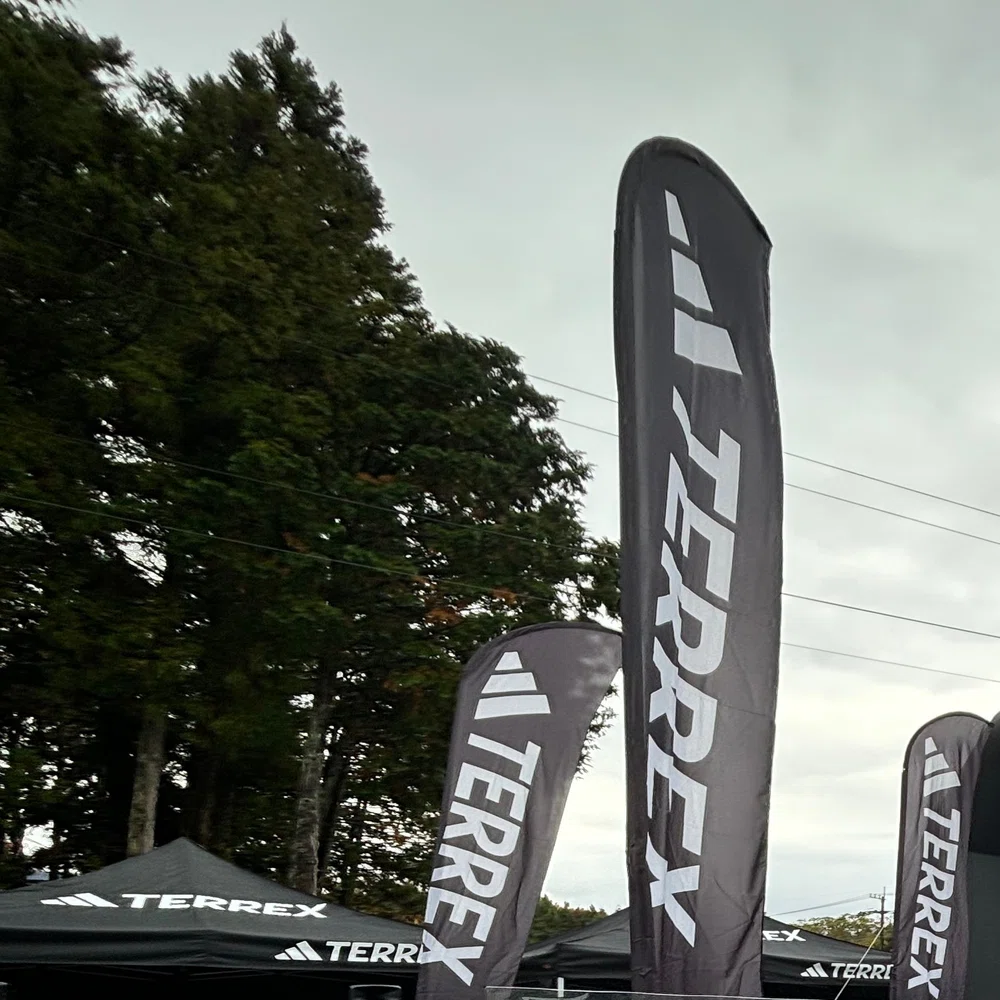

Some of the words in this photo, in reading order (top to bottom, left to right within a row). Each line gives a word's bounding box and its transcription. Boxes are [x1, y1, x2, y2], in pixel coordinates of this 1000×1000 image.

[646, 386, 741, 947] TERREX
[122, 893, 328, 919] TERREX
[420, 733, 541, 987] TERREX
[908, 808, 960, 999] TERREX
[326, 941, 422, 963] TERR
[762, 929, 806, 942] EX
